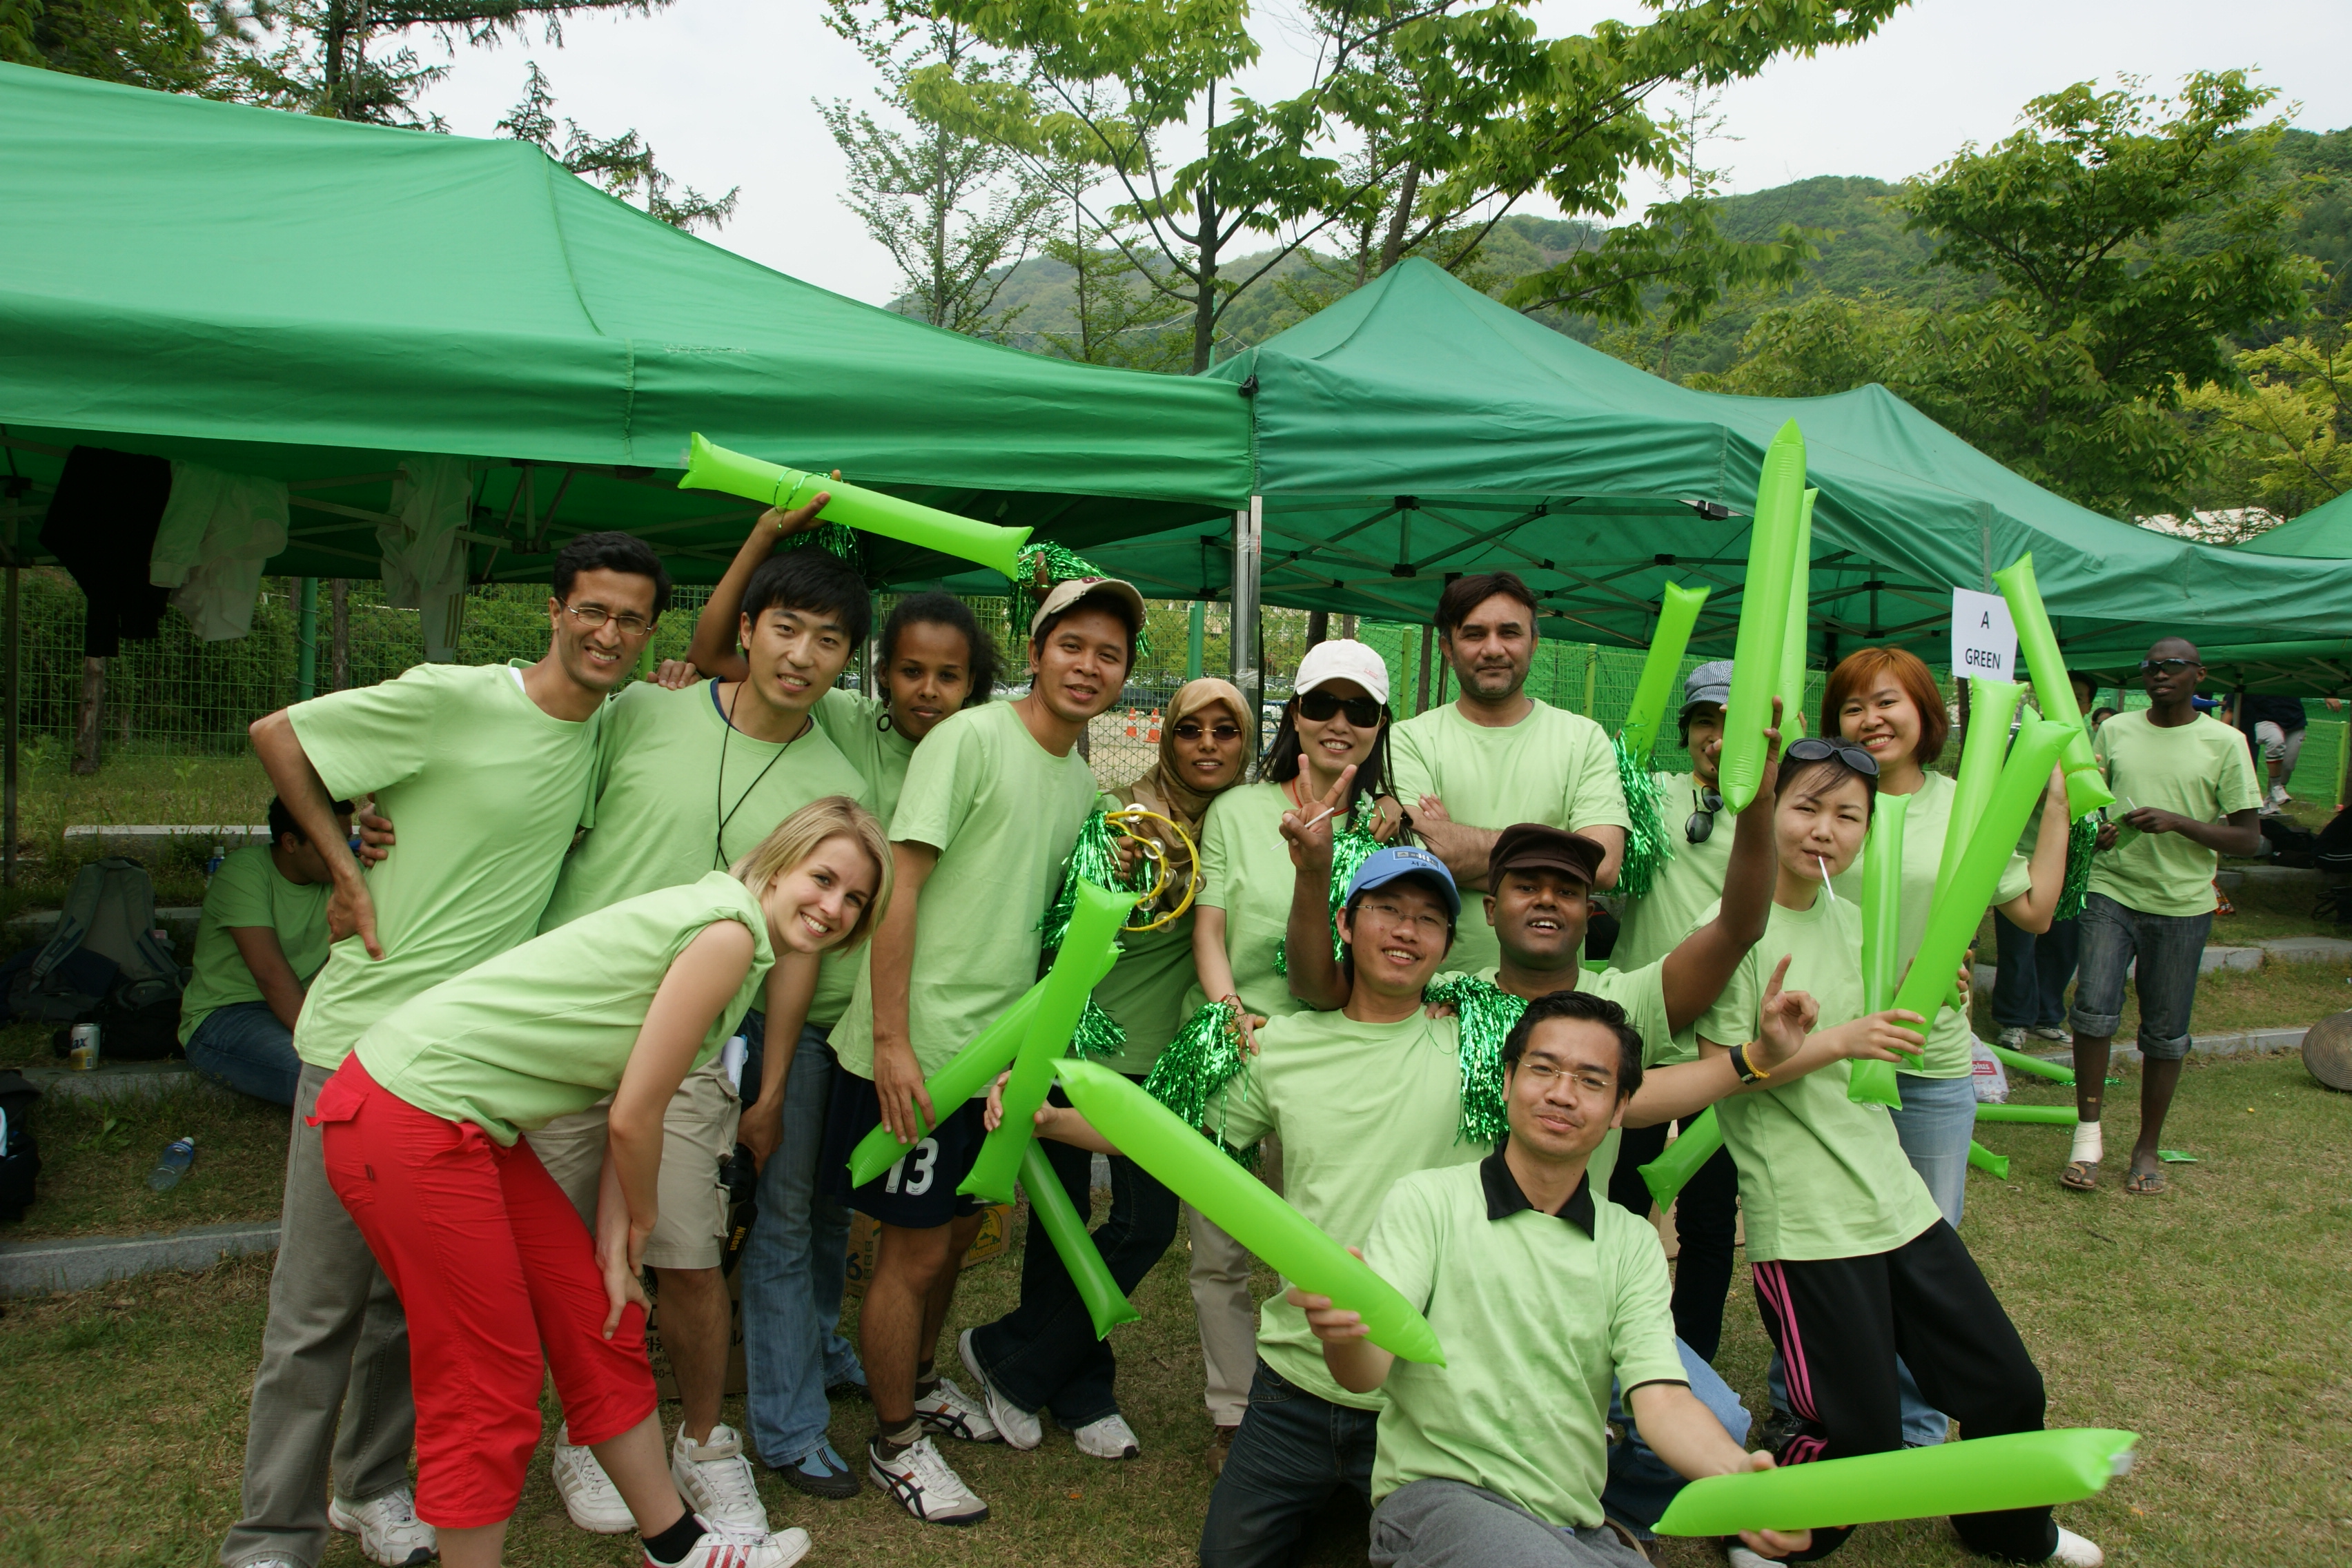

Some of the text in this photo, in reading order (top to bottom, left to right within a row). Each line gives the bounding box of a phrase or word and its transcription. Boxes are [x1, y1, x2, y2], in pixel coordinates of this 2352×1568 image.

[1980, 611, 1990, 629] A
[1965, 647, 2001, 670] GREEN
[885, 1137, 940, 1196] 13
[729, 1225, 747, 1251] Nikon
[968, 1242, 1001, 1262] Mountain
